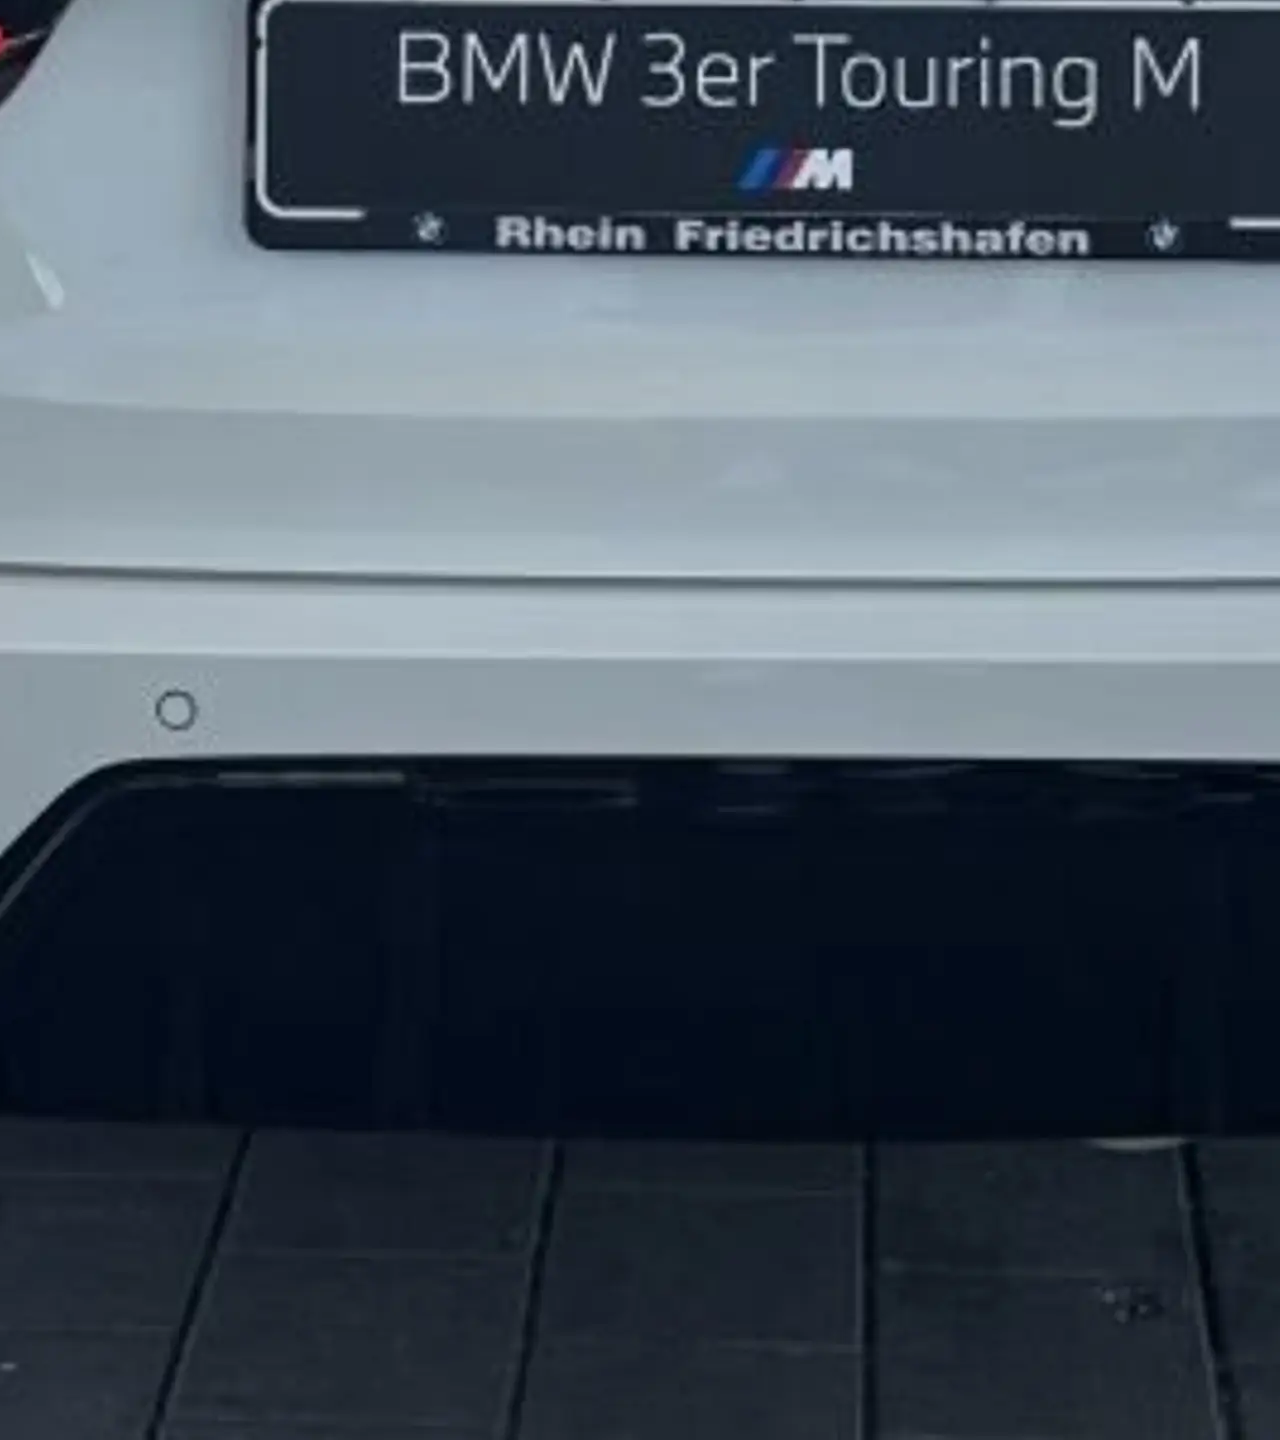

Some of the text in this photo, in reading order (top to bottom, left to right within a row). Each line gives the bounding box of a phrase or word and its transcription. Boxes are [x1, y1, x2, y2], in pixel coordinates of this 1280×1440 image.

[397, 31, 1202, 127] BMW 3er Touring M
[495, 215, 1090, 254] Rhein Friedrichshafen
